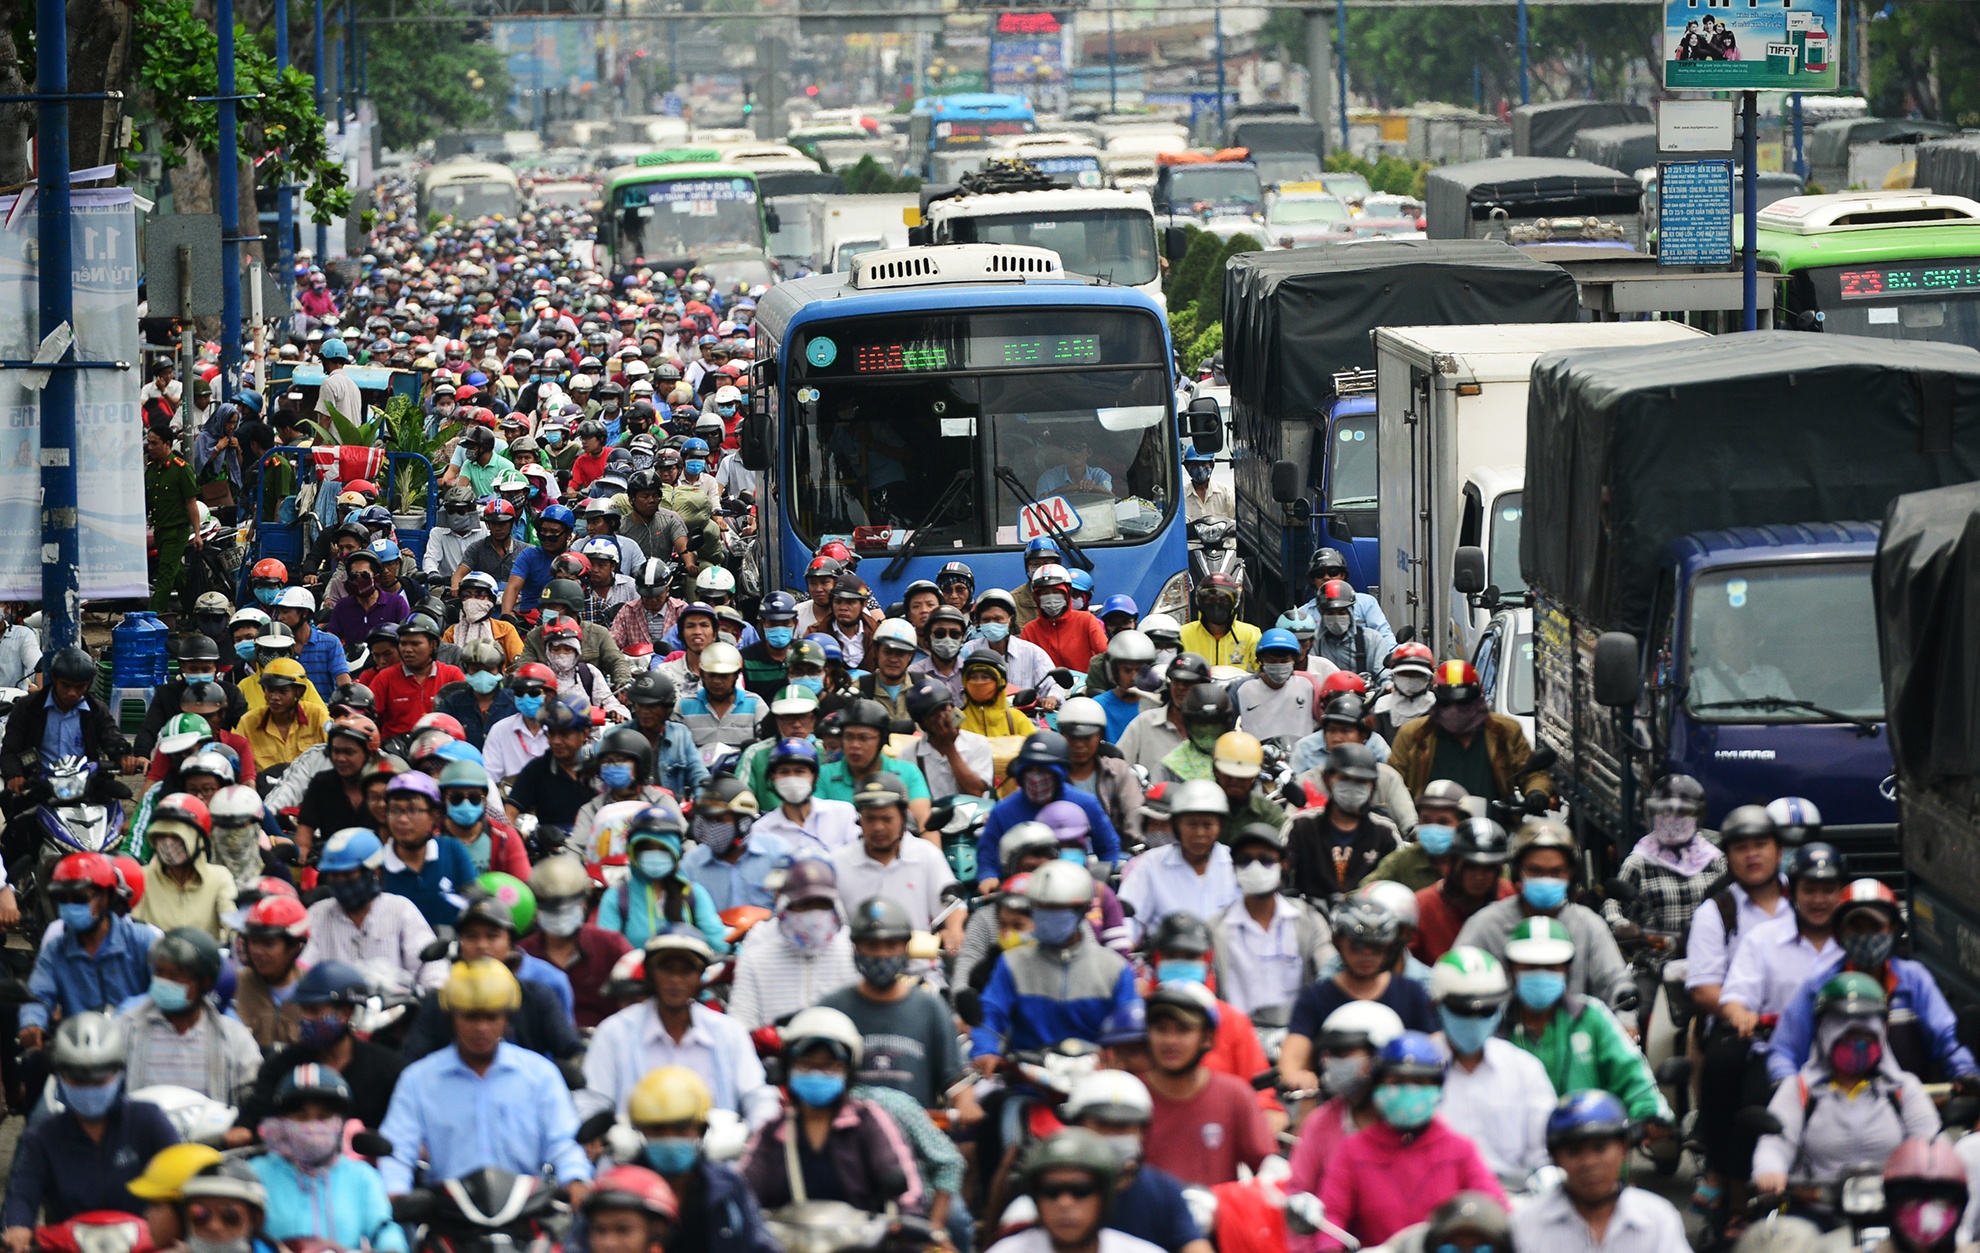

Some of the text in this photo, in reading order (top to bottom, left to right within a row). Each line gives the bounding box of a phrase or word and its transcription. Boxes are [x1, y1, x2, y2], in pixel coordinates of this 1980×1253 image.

[1769, 45, 1798, 56] TIFFY
[1840, 270, 1882, 295] 23
[1022, 497, 1070, 538] 104
